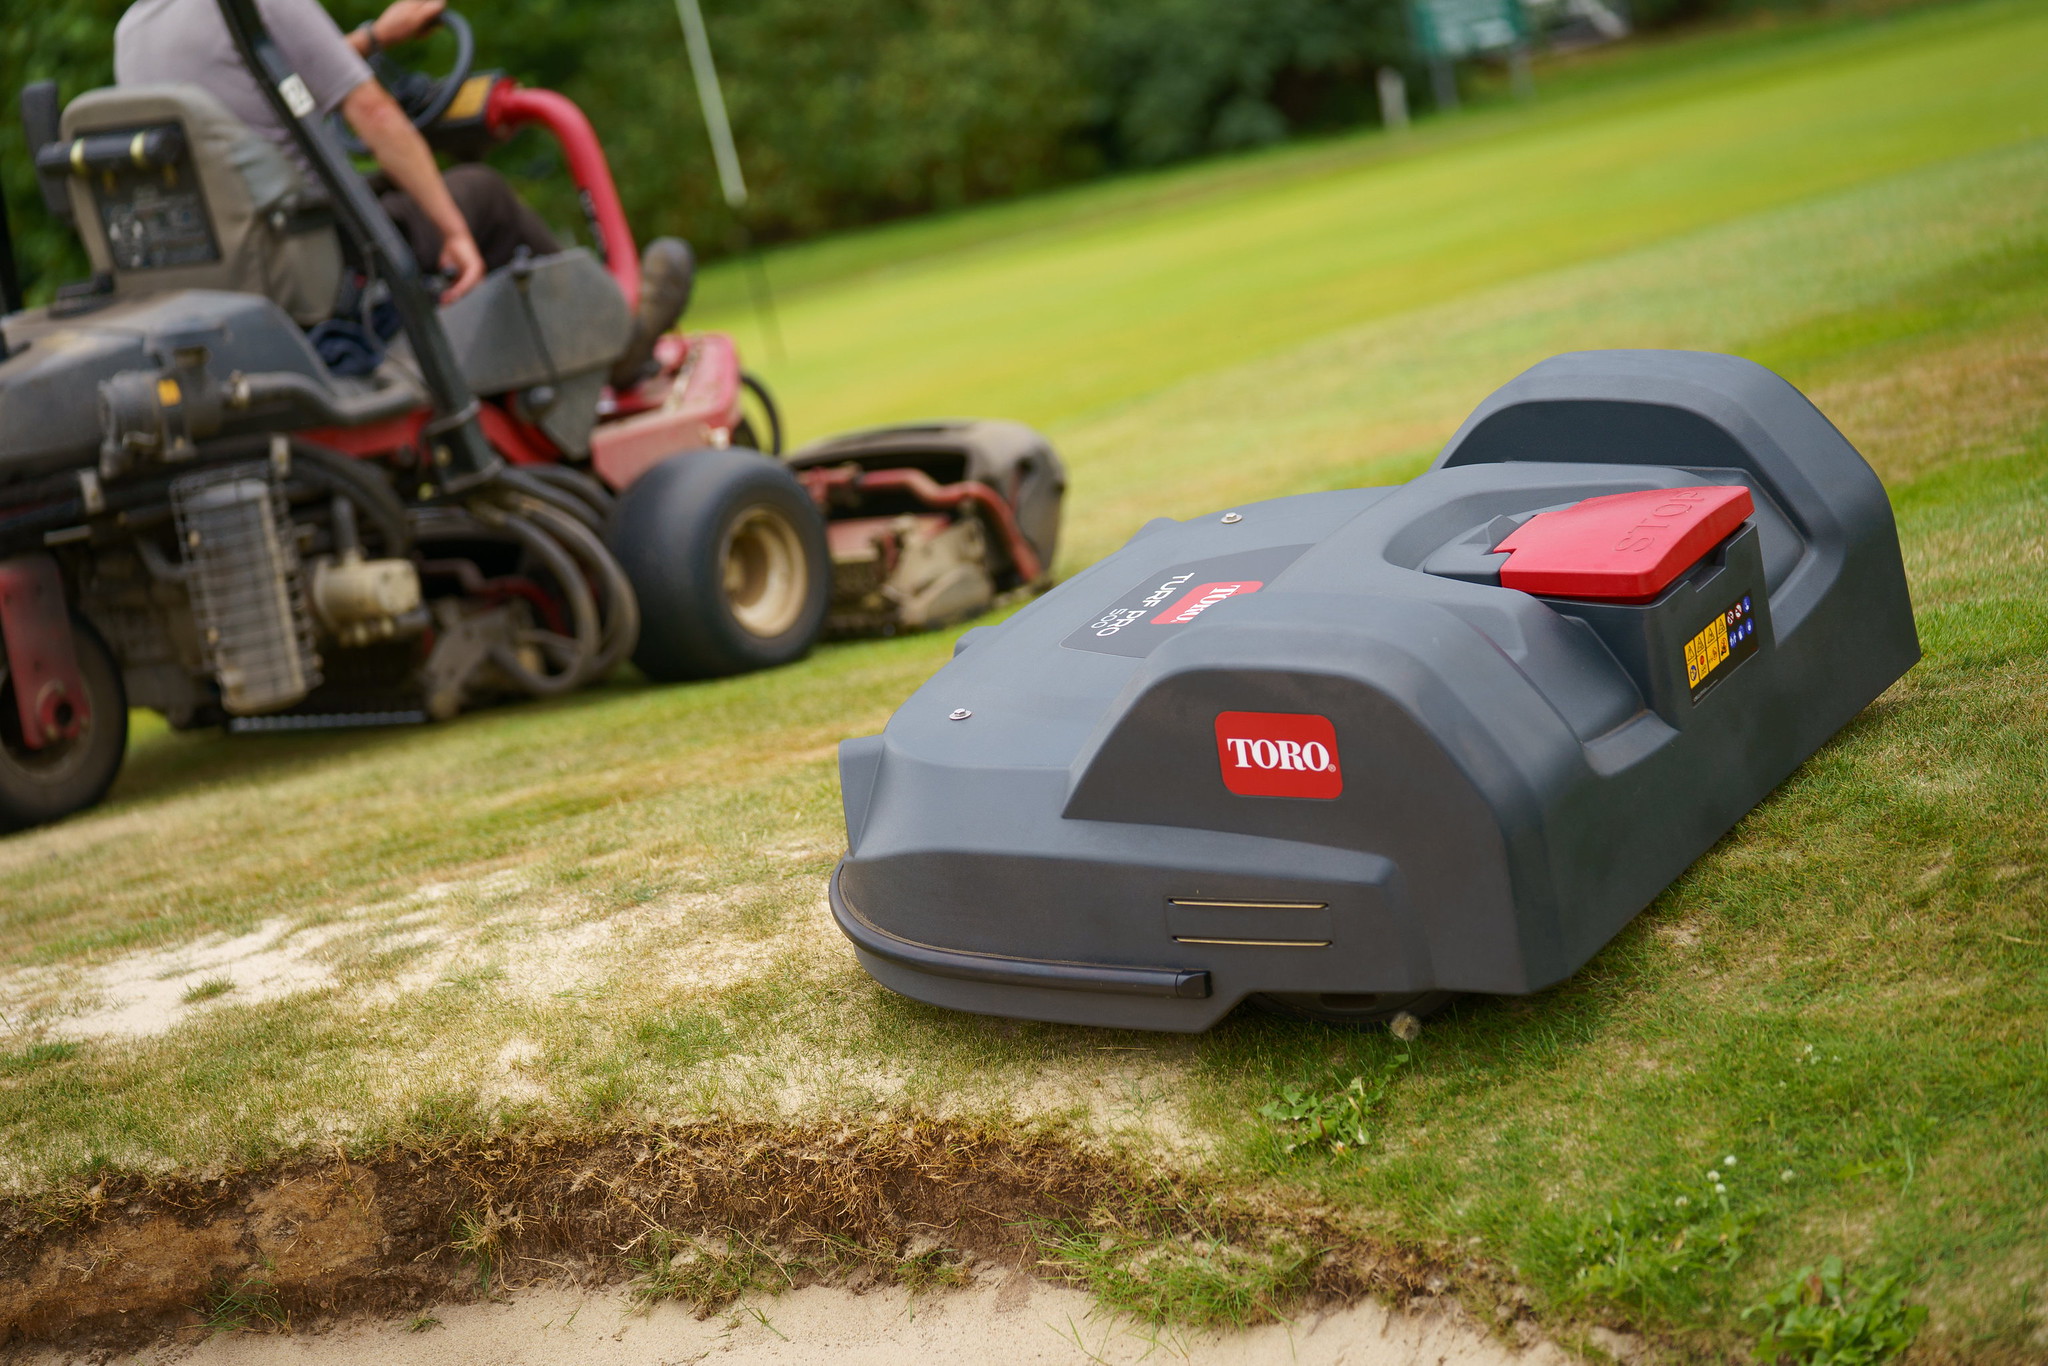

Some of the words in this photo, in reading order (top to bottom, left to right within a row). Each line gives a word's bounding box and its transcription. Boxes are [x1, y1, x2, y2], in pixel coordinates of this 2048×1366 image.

[1615, 490, 1704, 552] STOP
[1142, 572, 1195, 607] TURF
[1091, 608, 1128, 628] 500
[1096, 610, 1147, 636] PRO
[1227, 738, 1331, 772] TORO
